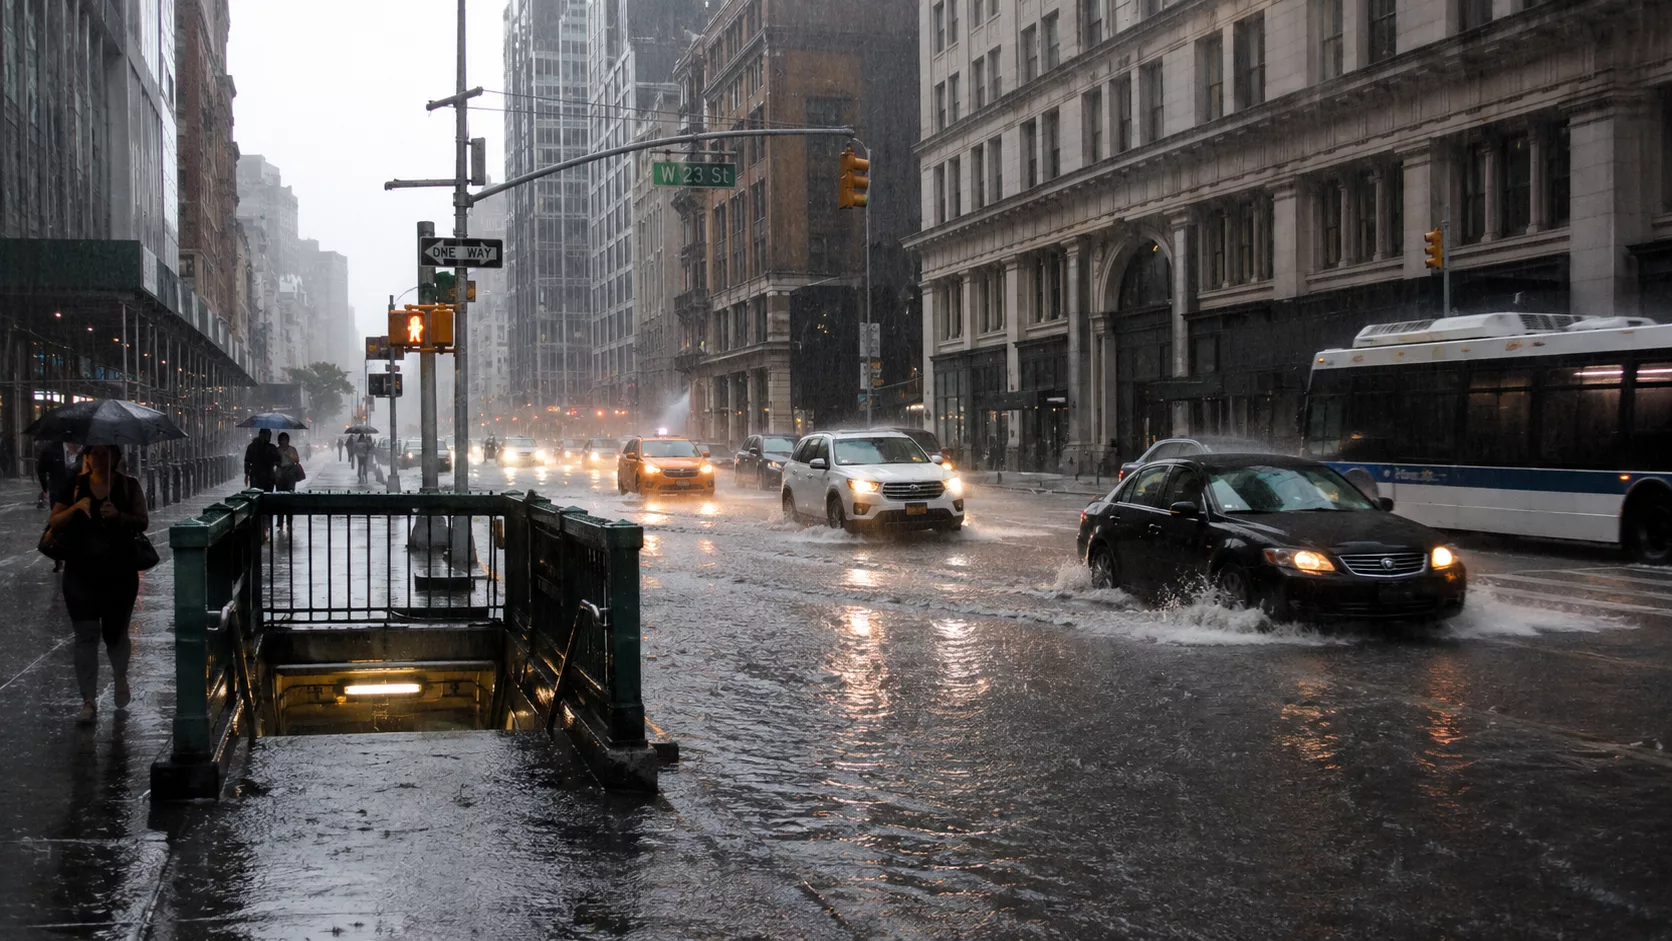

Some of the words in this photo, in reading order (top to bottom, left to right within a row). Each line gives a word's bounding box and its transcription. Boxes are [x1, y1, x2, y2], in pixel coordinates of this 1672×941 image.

[661, 166, 675, 183] W
[683, 166, 703, 183] 23
[712, 167, 729, 184] St
[432, 247, 456, 258] ONE
[467, 247, 492, 258] WAY
